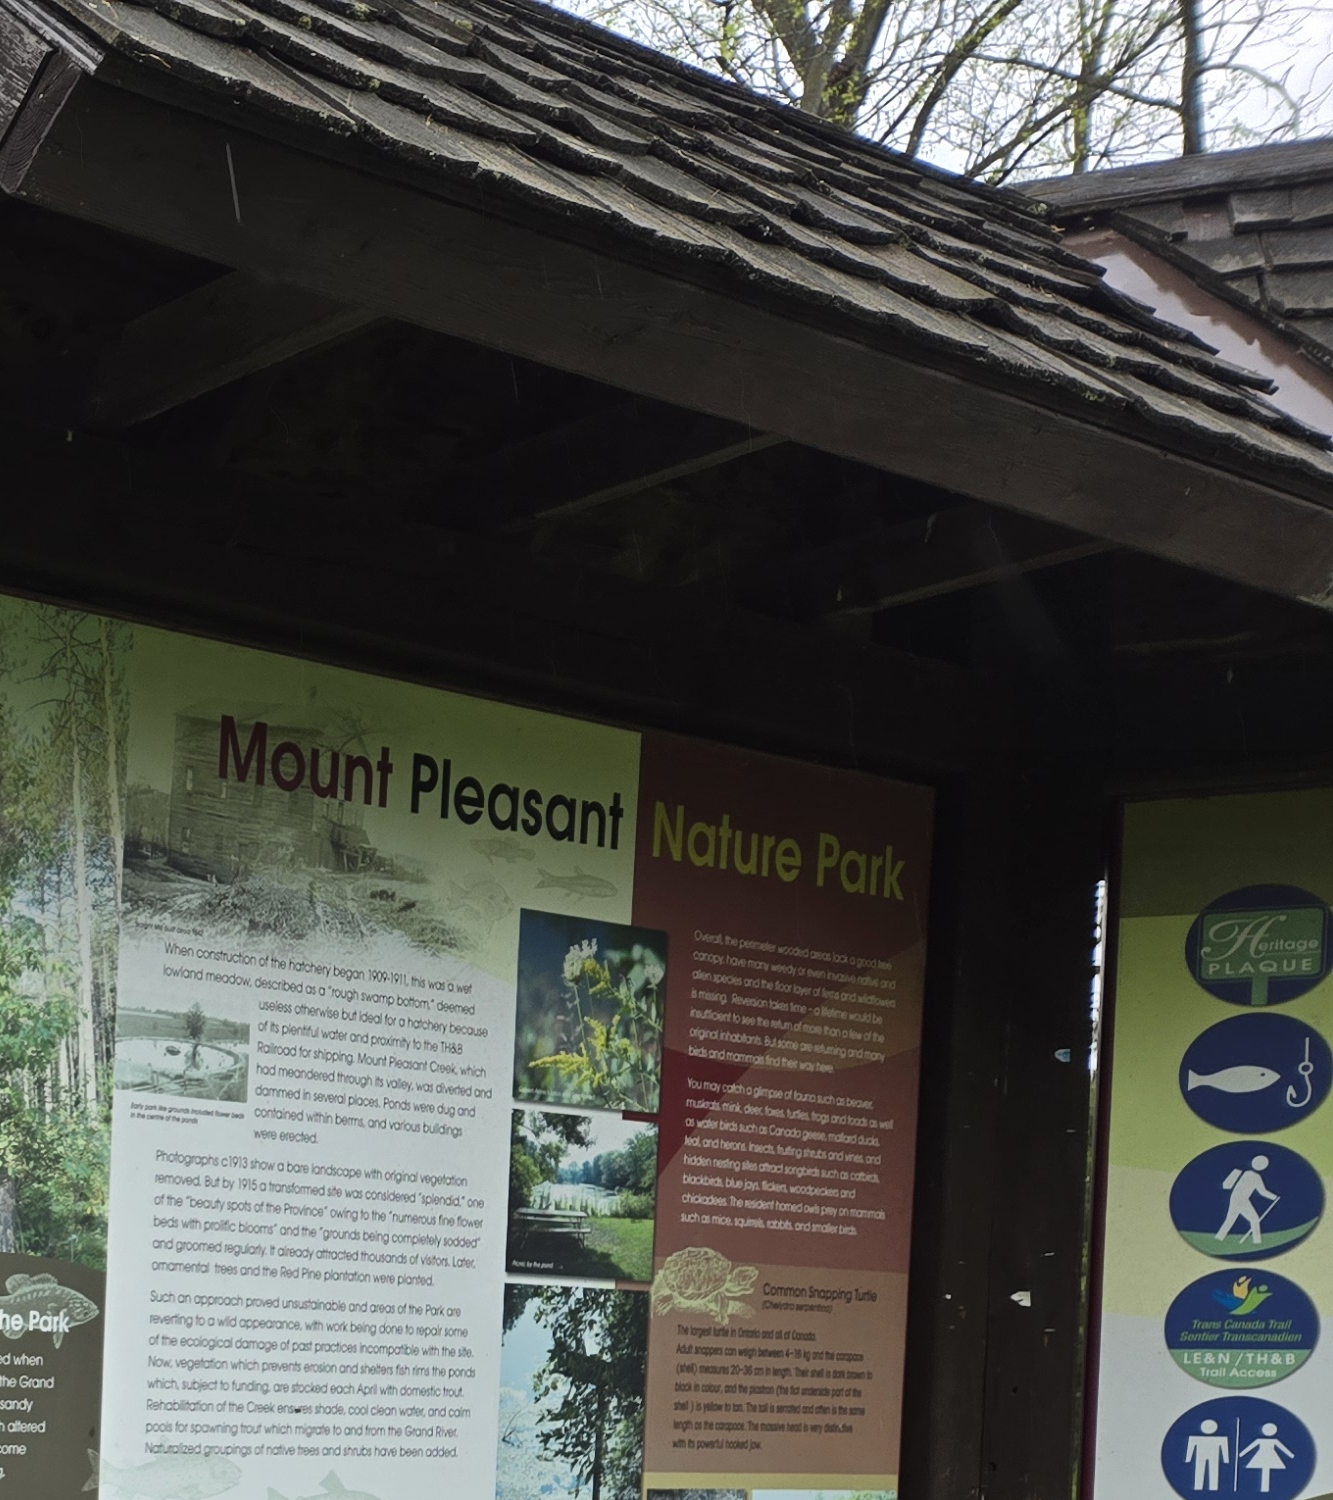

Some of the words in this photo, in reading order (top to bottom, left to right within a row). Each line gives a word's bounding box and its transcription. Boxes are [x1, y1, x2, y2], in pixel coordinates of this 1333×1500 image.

[218, 714, 393, 808] Mount
[410, 753, 624, 851] Pleasant
[653, 801, 802, 882] Nature
[817, 832, 905, 901] Park
[1201, 914, 1319, 961] Heritage
[164, 941, 194, 957] When
[195, 946, 256, 965] construction
[258, 949, 269, 967] of
[270, 950, 286, 970] the
[288, 955, 331, 977] hatchery
[333, 964, 364, 981] began
[368, 968, 408, 986] 1909-1911,
[410, 975, 425, 988] this
[427, 979, 445, 990] was
[446, 980, 454, 992] a
[456, 983, 472, 994] wet
[1209, 958, 1312, 975] PLAQUE
[155, 1148, 219, 1167] Photographs
[220, 1155, 248, 1169] c1913
[249, 1157, 275, 1170] show
[276, 1162, 284, 1172] a
[286, 1160, 309, 1174] bare
[311, 1163, 361, 1179] landscape
[363, 1168, 382, 1179] with
[384, 1169, 418, 1184] original
[419, 1173, 467, 1187] vegetation
[762, 1281, 807, 1297] Common
[808, 1285, 852, 1304] Snapping
[854, 1287, 877, 1302] Turtle
[28, 1309, 70, 1333] Park
[1192, 1320, 1220, 1329] Trans
[1224, 1319, 1265, 1329] Canada
[1269, 1320, 1292, 1329] Trail
[1180, 1332, 1219, 1341] Sentier
[1223, 1332, 1302, 1342] Transcanadien
[12, 1352, 43, 1366] when
[1184, 1353, 1230, 1364] LE&N
[1200, 1368, 1226, 1377] Trail
[1229, 1368, 1277, 1377] Access
[18, 1375, 54, 1388] Grand
[0, 1397, 33, 1412] sandy
[7, 1420, 45, 1432] altered
[144, 1441, 202, 1455] Naturalized
[203, 1443, 252, 1458] groupings
[254, 1443, 264, 1455] of
[266, 1444, 295, 1455] native
[297, 1444, 319, 1456] trees
[321, 1444, 341, 1456] and
[342, 1444, 372, 1456] shrubs
[374, 1445, 397, 1457] have
[399, 1445, 423, 1457] been
[425, 1445, 458, 1457] added.
